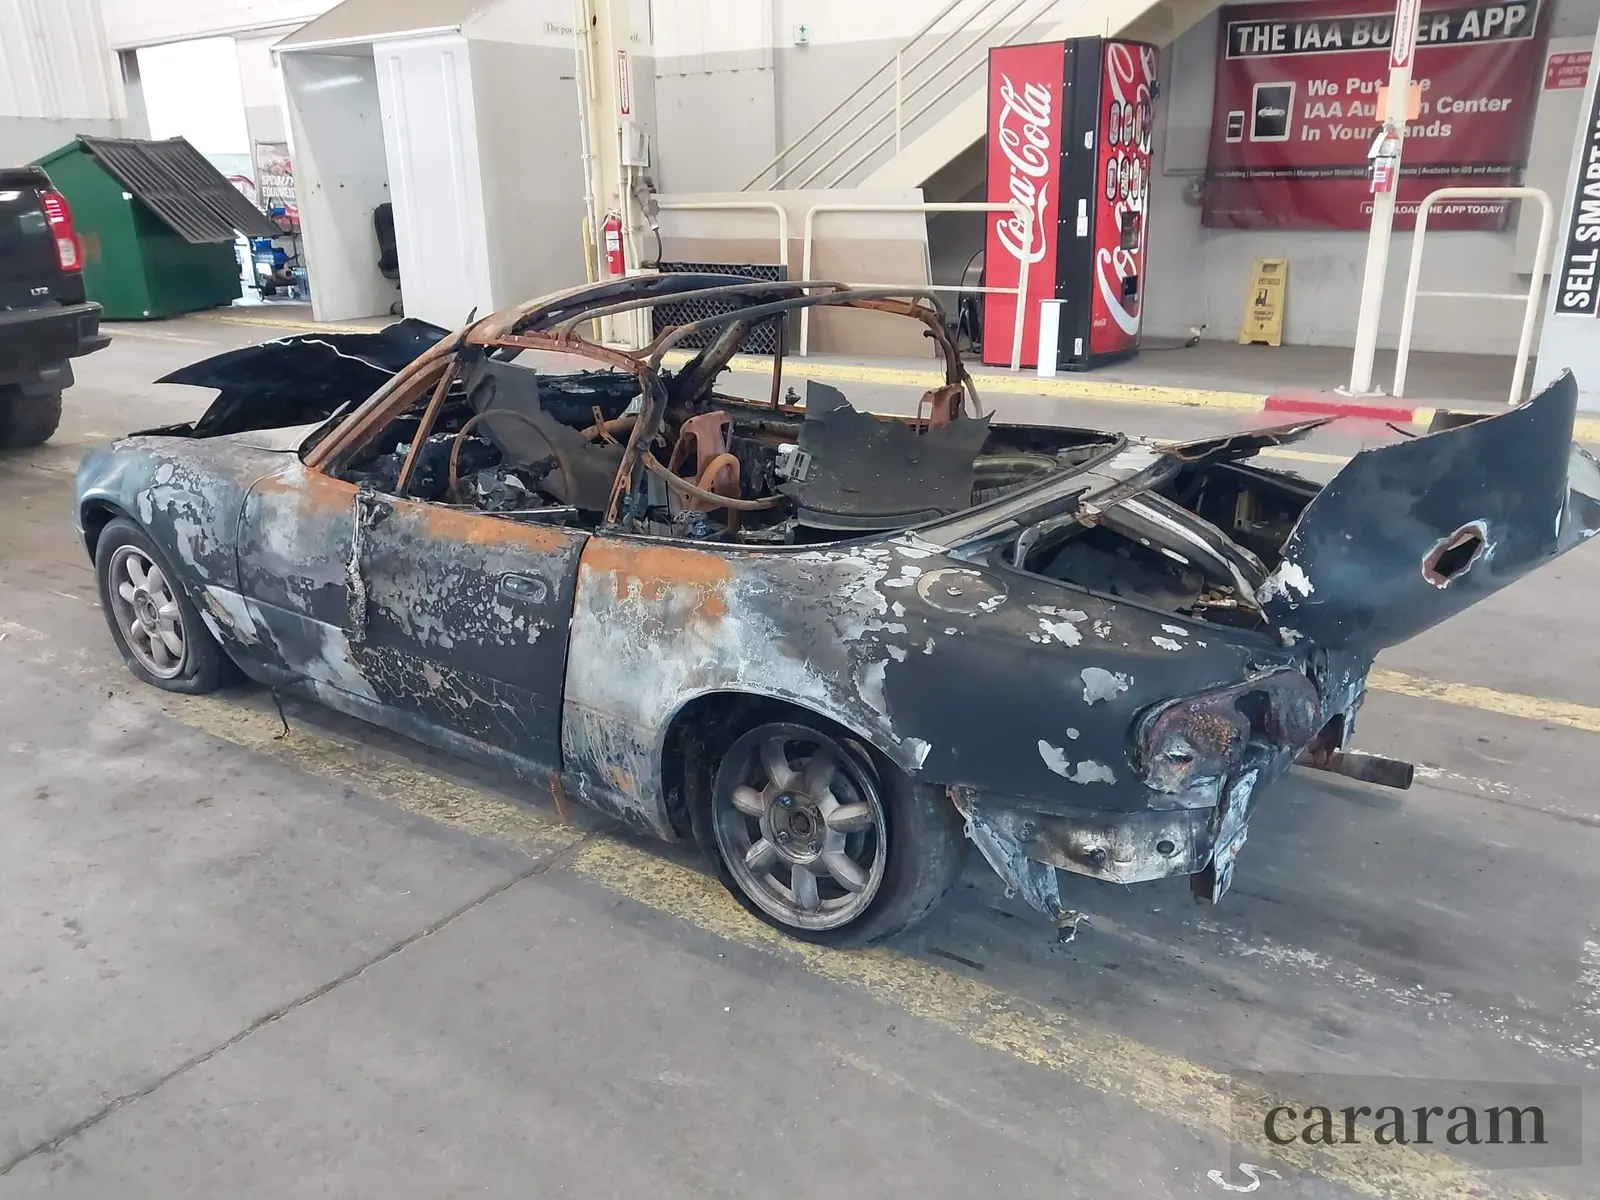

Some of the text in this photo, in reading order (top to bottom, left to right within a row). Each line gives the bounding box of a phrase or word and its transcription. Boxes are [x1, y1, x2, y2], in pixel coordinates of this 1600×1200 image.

[545, 23, 559, 33] The
[1237, 4, 1526, 53] THE IAA BUER APP
[1308, 77, 1383, 96] We Put
[1304, 101, 1342, 119] IAA
[1436, 96, 1513, 114] Center
[1301, 121, 1453, 141] In Your ands
[1421, 166, 1450, 175] Available
[1451, 166, 1460, 174] for
[1473, 165, 1485, 173] and
[1365, 205, 1421, 214] DLOAD
[1444, 205, 1466, 214] APP
[1467, 204, 1504, 214] TODAY!
[1563, 249, 1599, 308] SELL
